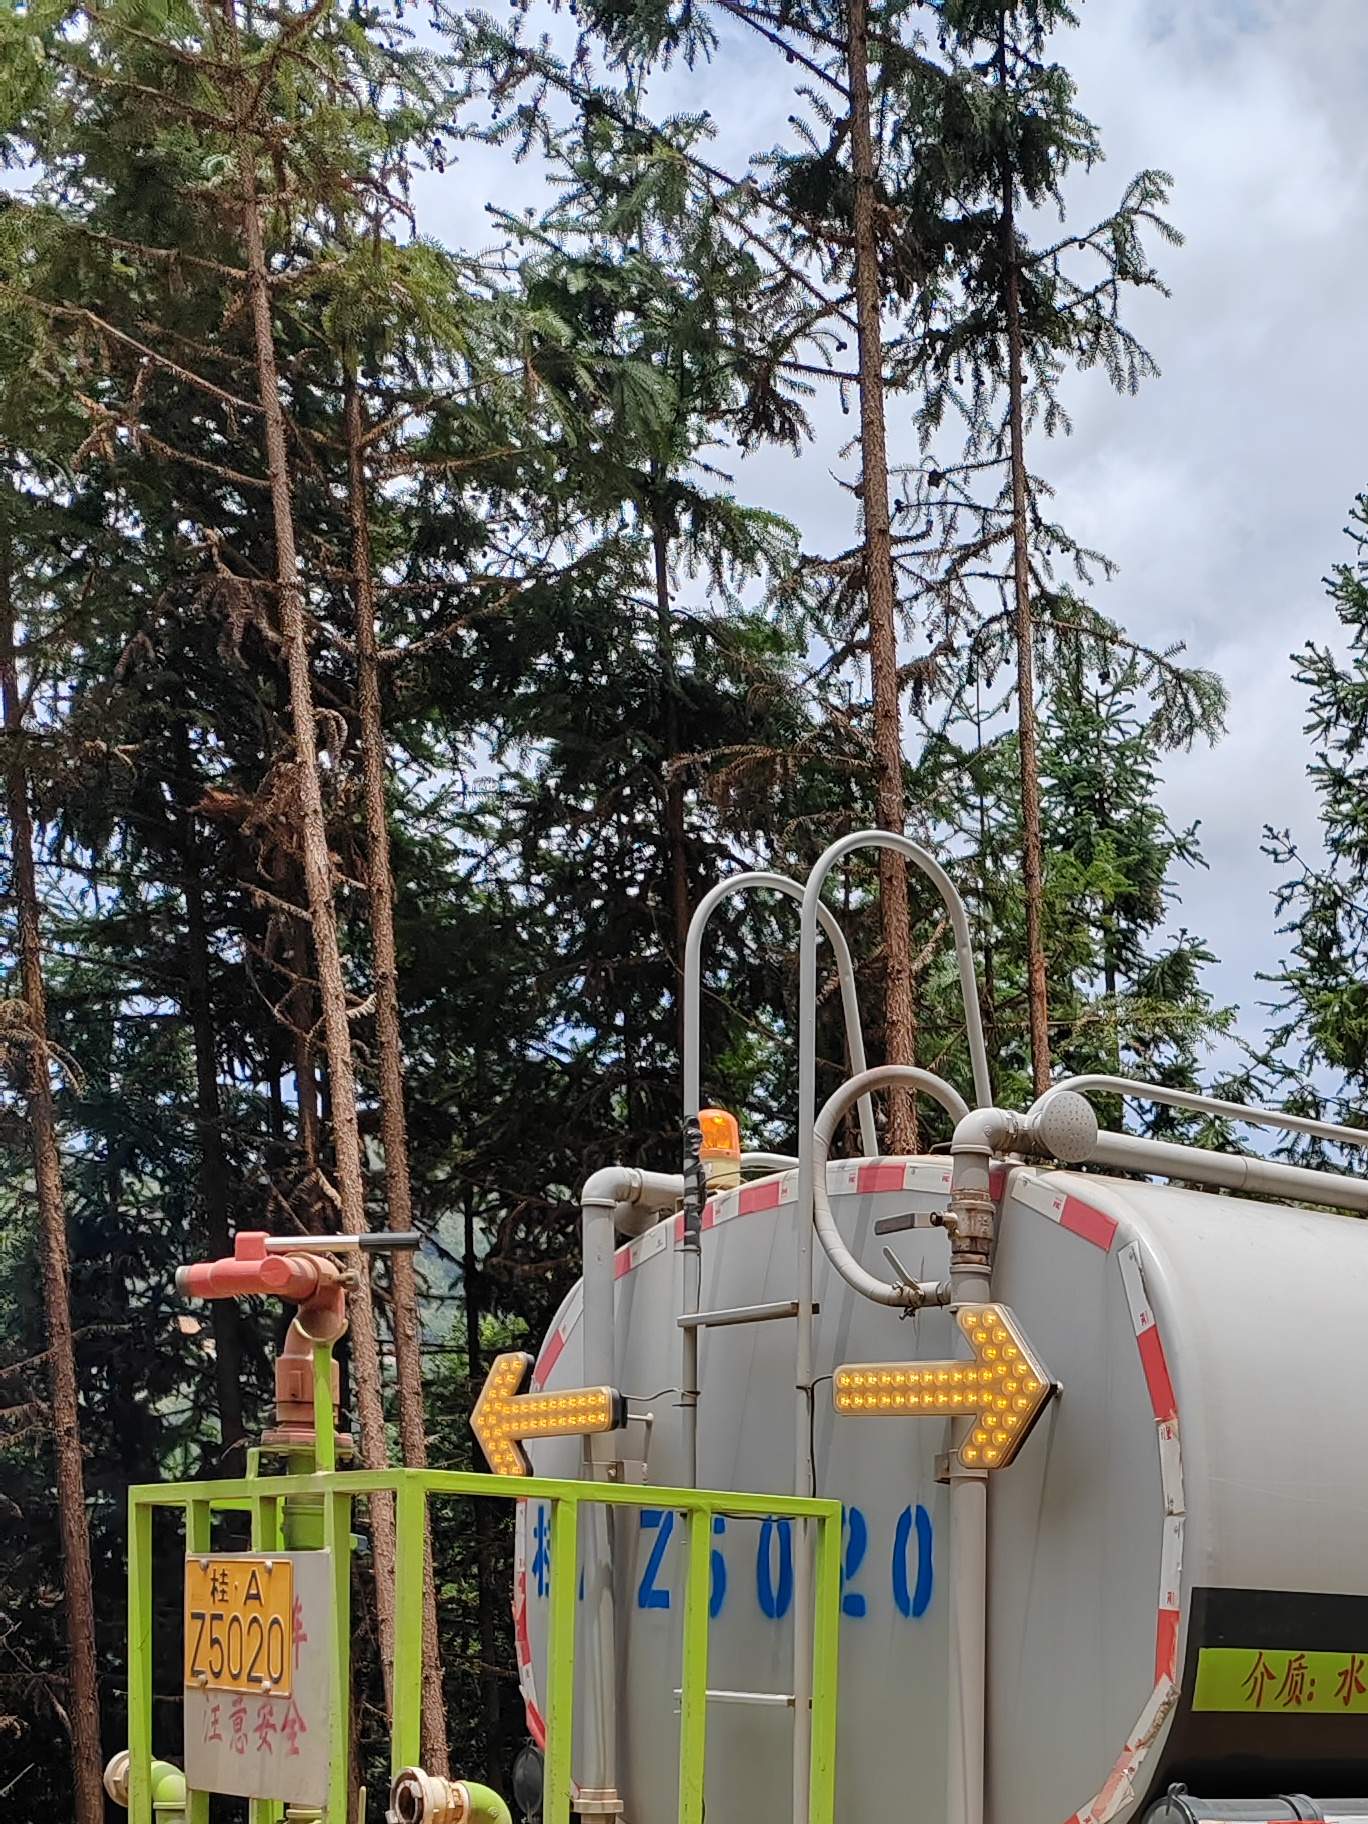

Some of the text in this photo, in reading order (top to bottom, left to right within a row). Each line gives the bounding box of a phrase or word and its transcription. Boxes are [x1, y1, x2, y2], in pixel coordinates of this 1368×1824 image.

[189, 1611, 285, 1686] Z5020
[1334, 1654, 1367, 1707] 水
[202, 1694, 308, 1757] 注意安全
